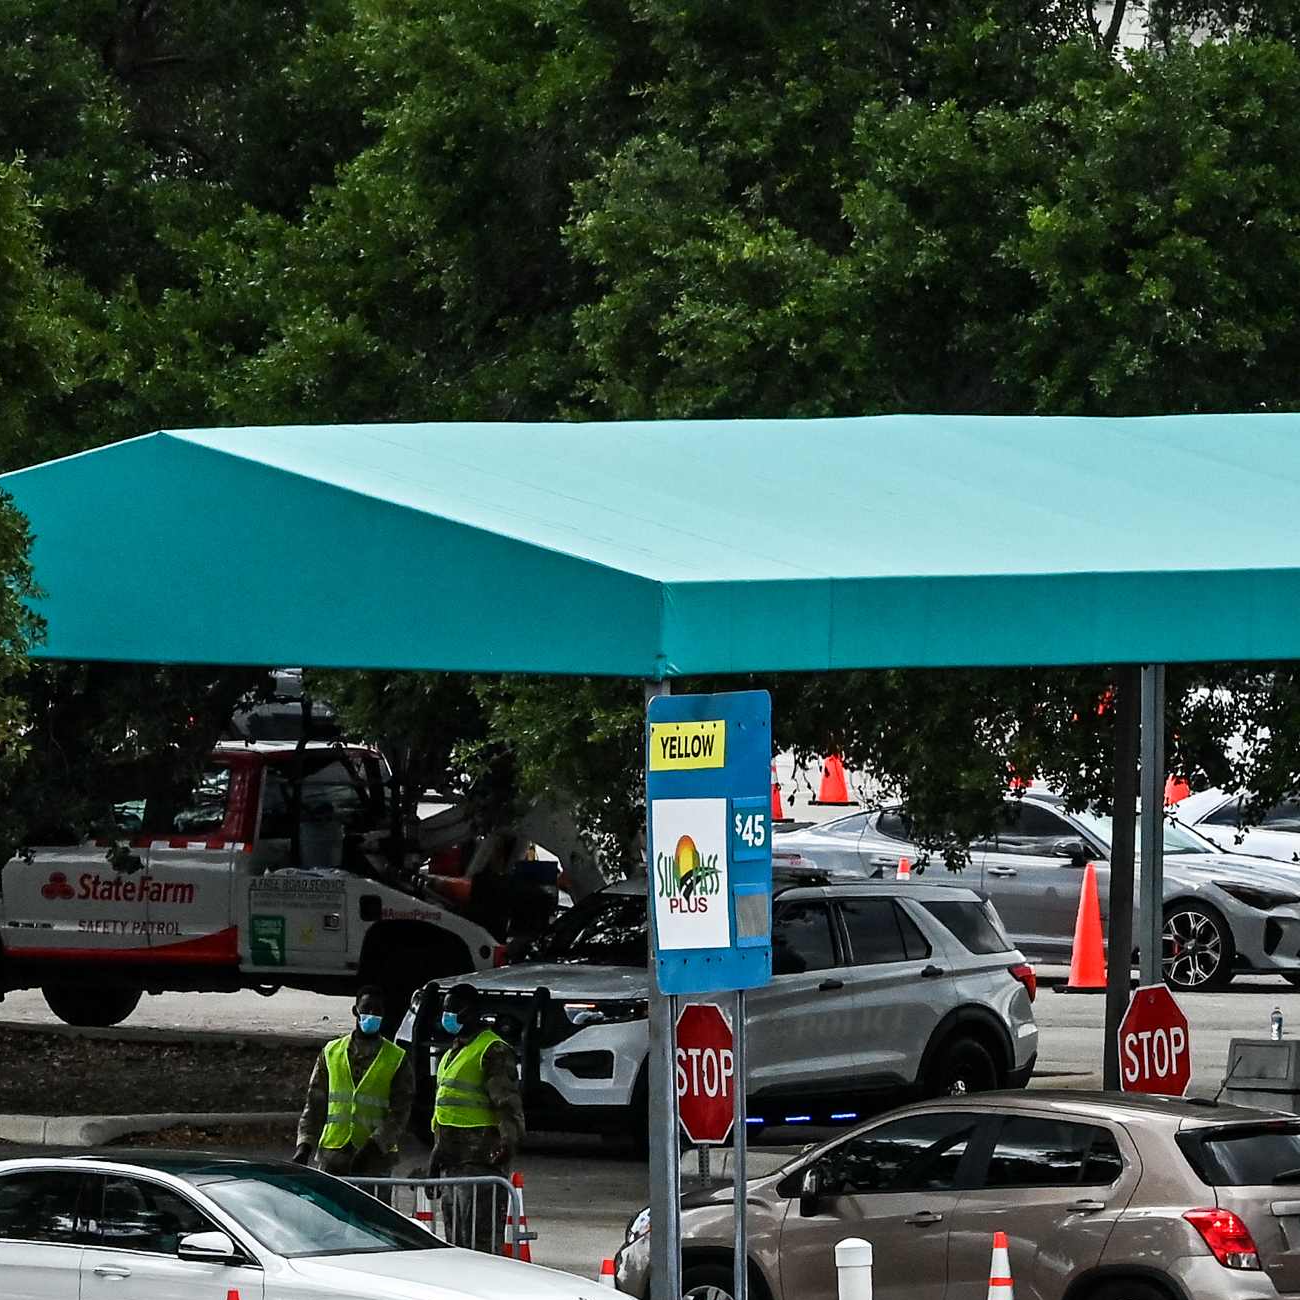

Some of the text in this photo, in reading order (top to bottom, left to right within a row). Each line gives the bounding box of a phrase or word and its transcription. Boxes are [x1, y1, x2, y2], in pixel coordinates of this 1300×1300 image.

[660, 735, 715, 759] YELLOW
[734, 813, 765, 847] $45
[670, 897, 708, 914] PLUS
[78, 920, 183, 936] SAFETY PATROL
[1125, 1026, 1185, 1082] STOP
[676, 1048, 733, 1097] STOP
